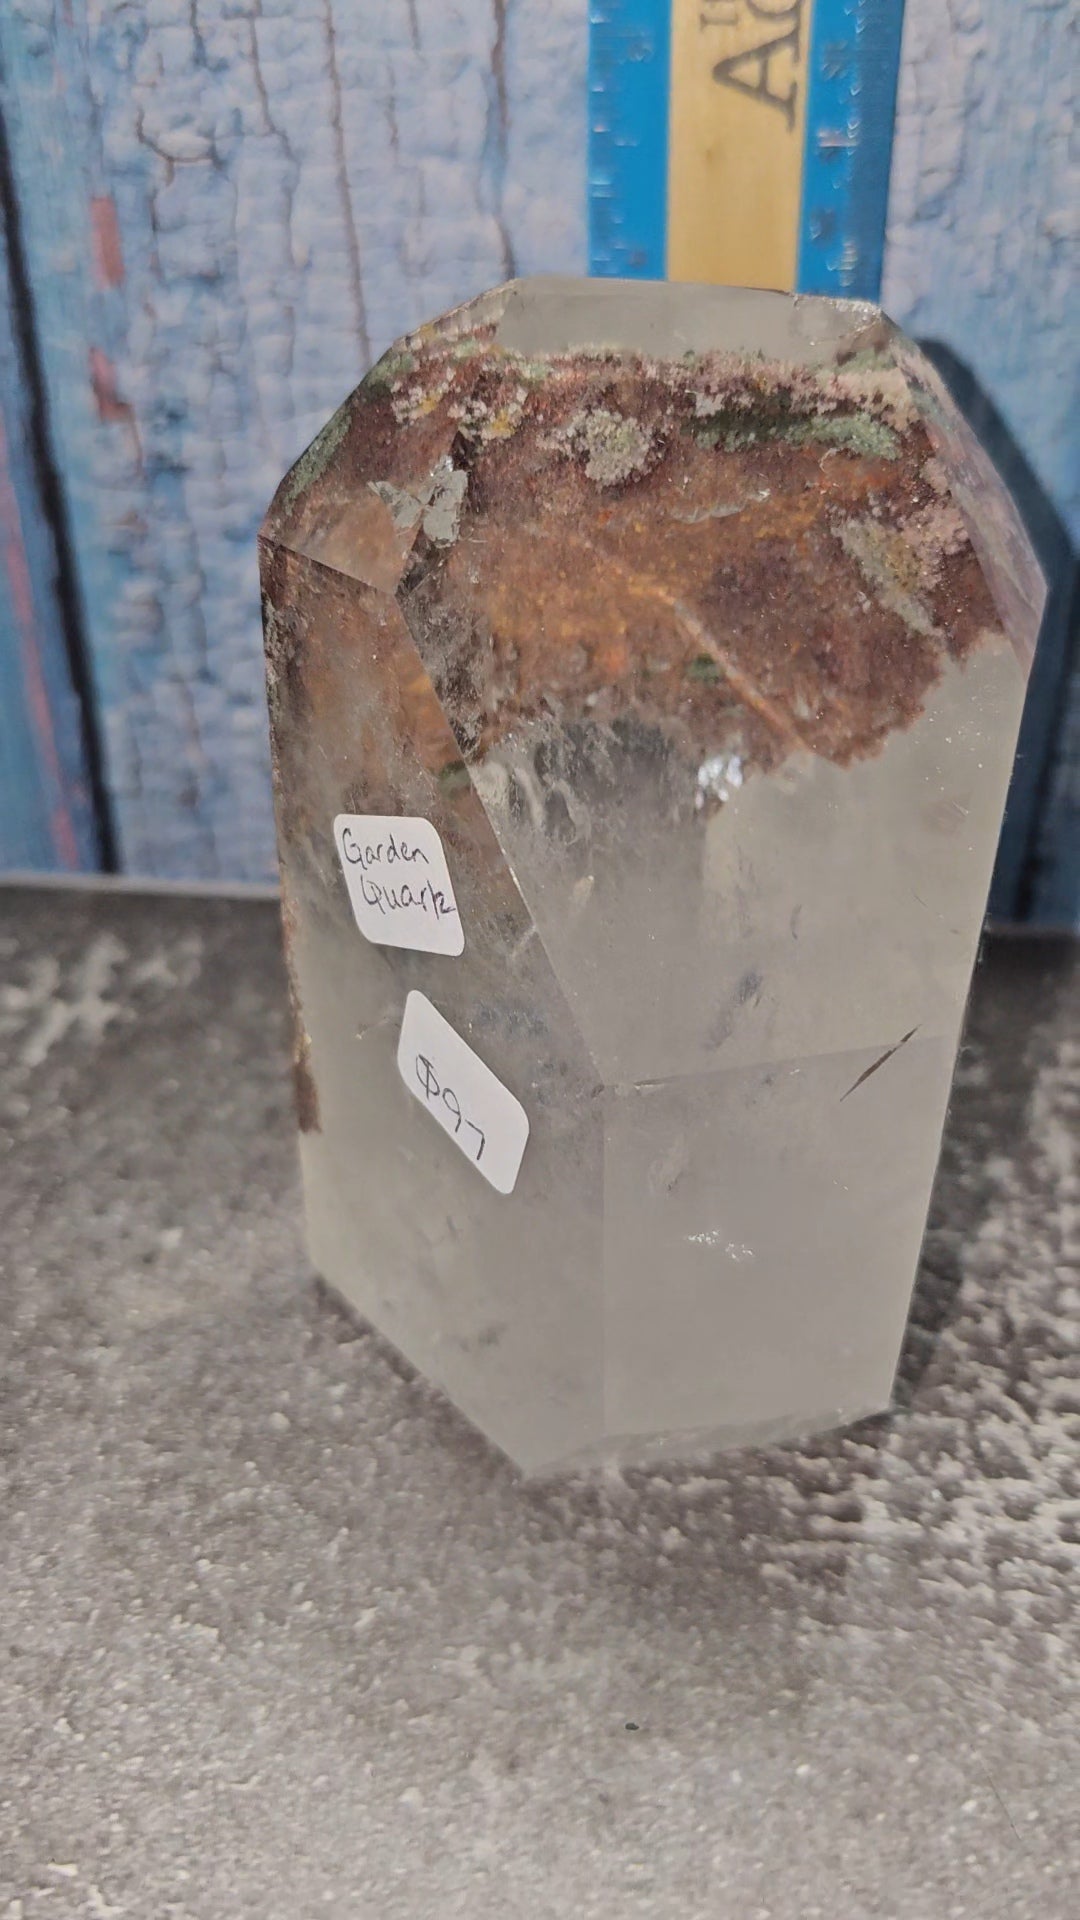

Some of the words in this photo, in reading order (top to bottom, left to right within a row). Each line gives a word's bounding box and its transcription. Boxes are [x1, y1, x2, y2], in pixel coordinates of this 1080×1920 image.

[342, 827, 430, 871] Garden
[360, 875, 457, 920] Quartz
[415, 1053, 486, 1161] $97
